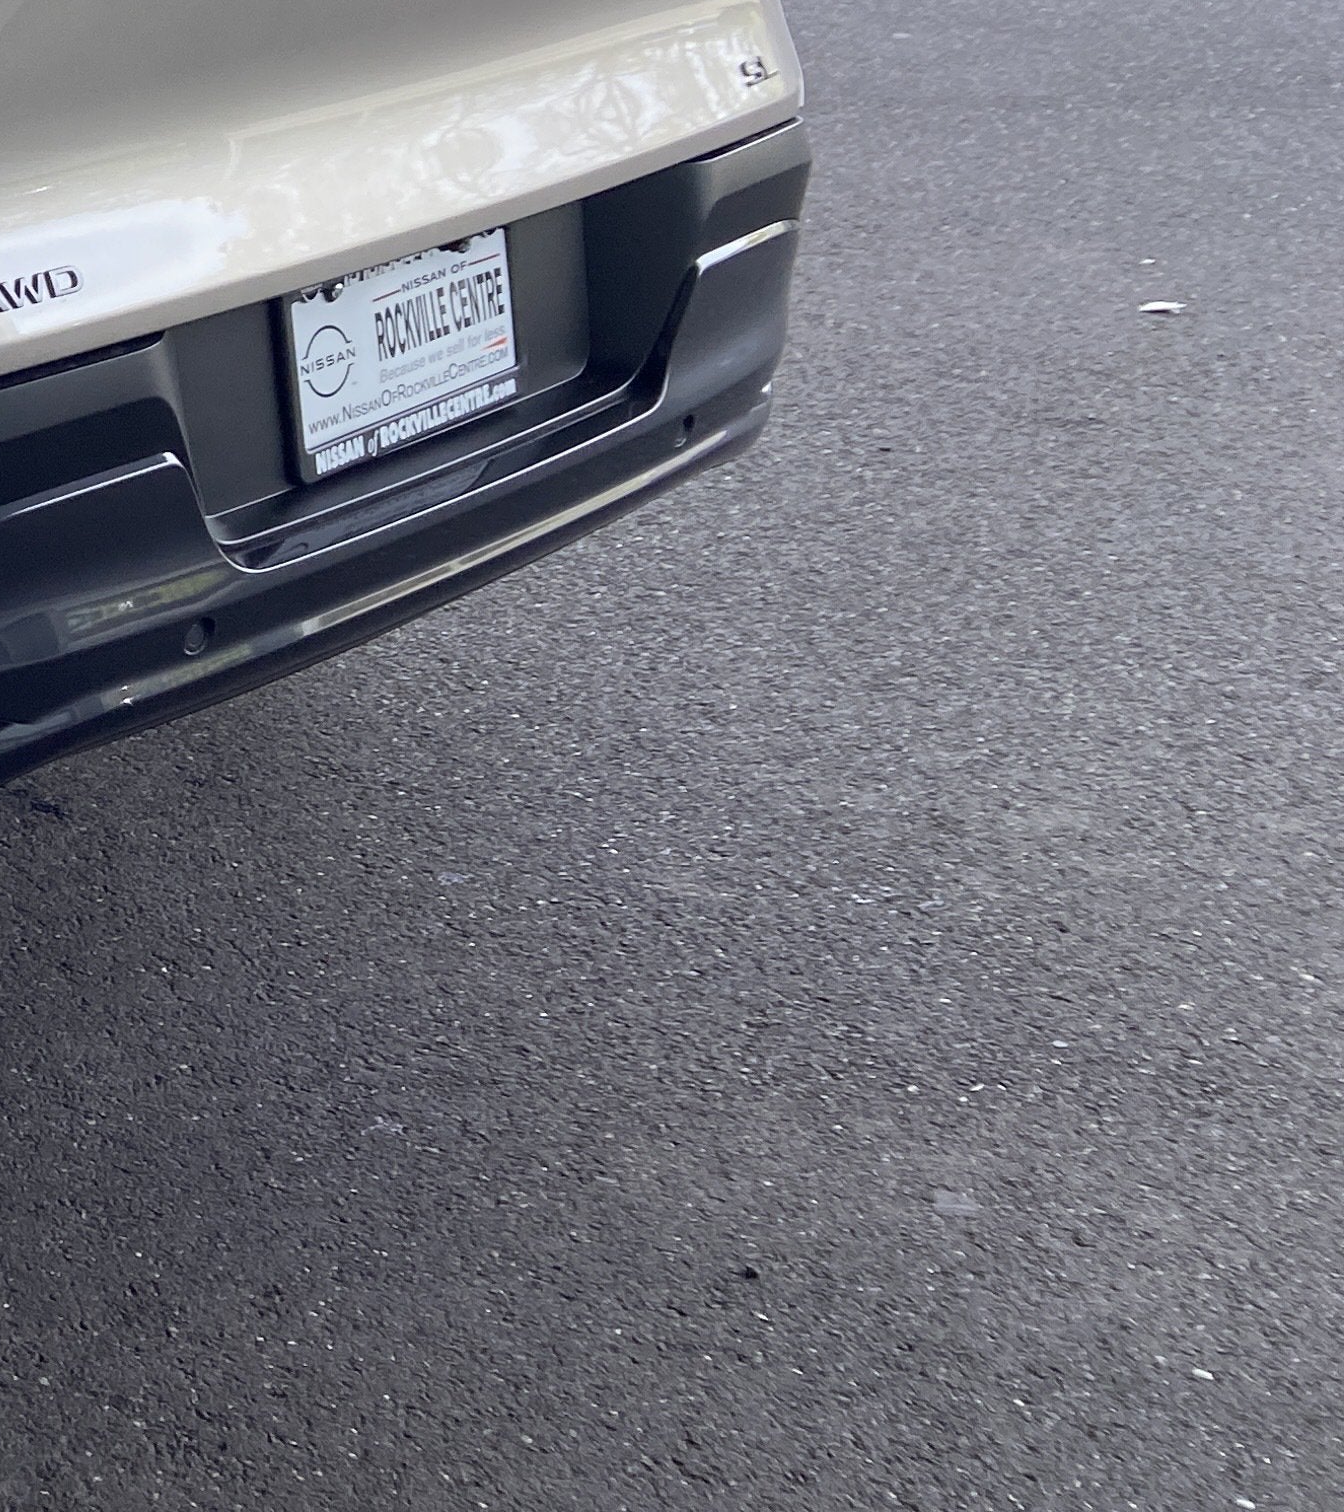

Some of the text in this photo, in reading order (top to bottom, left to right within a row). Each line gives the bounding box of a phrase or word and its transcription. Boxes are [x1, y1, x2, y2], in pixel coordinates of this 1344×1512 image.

[738, 55, 781, 88] SL
[400, 268, 447, 293] NISSAN
[450, 260, 468, 275] OF
[374, 286, 451, 362] ROCKVILLE
[451, 266, 506, 332] CENTRE
[300, 346, 357, 377] NISSAN
[379, 356, 426, 384] Because
[427, 349, 444, 365] we
[446, 338, 465, 357] sell
[467, 333, 482, 348] for
[315, 435, 365, 475] NISSAN
[367, 430, 380, 457] of
